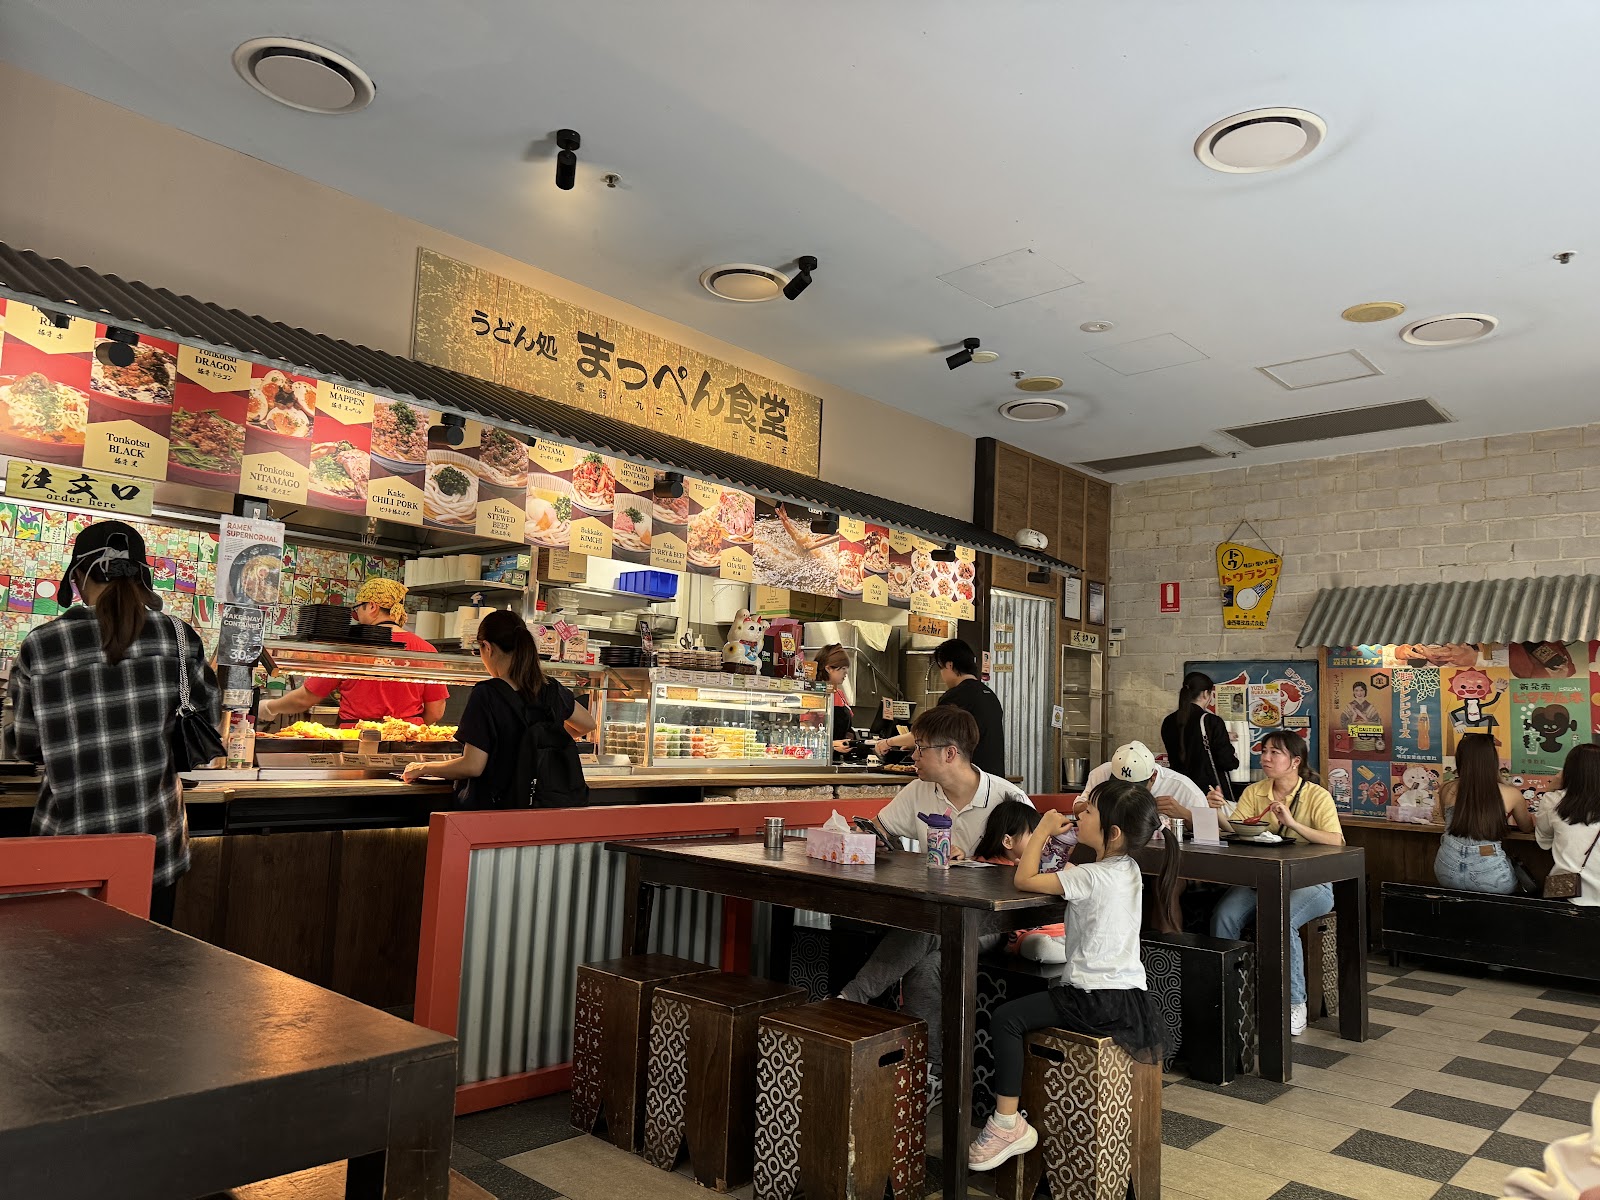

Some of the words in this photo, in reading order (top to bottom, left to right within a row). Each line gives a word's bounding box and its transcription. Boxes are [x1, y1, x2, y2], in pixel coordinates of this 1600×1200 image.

[471, 309, 558, 361] うどん処
[195, 355, 237, 373] DRAGON
[329, 391, 366, 406] MAPPEN
[106, 432, 150, 448] Tonkotsu
[109, 445, 146, 458] BLACK
[538, 445, 566, 457] ONTAMA
[258, 463, 295, 478] Tonkotsu
[623, 462, 648, 474] ONTAMA
[249, 472, 300, 488] NITAMAGO
[621, 469, 650, 482] MENTAIKO
[21, 466, 141, 500] 注文口
[387, 488, 405, 499] Kake
[47, 493, 83, 504] order
[89, 498, 116, 509] here
[372, 495, 394, 506] CHILI
[396, 499, 418, 510] PORK
[494, 505, 510, 515] Kake
[487, 512, 516, 523] STEWED
[227, 522, 253, 532] RAMEN
[492, 521, 510, 531] BEEF
[226, 530, 278, 543] SUPERNORMAL
[580, 535, 603, 545] KIMCHI
[663, 542, 675, 550] Kake
[1221, 564, 1280, 585] トウランプ
[1121, 766, 1131, 778] NY
